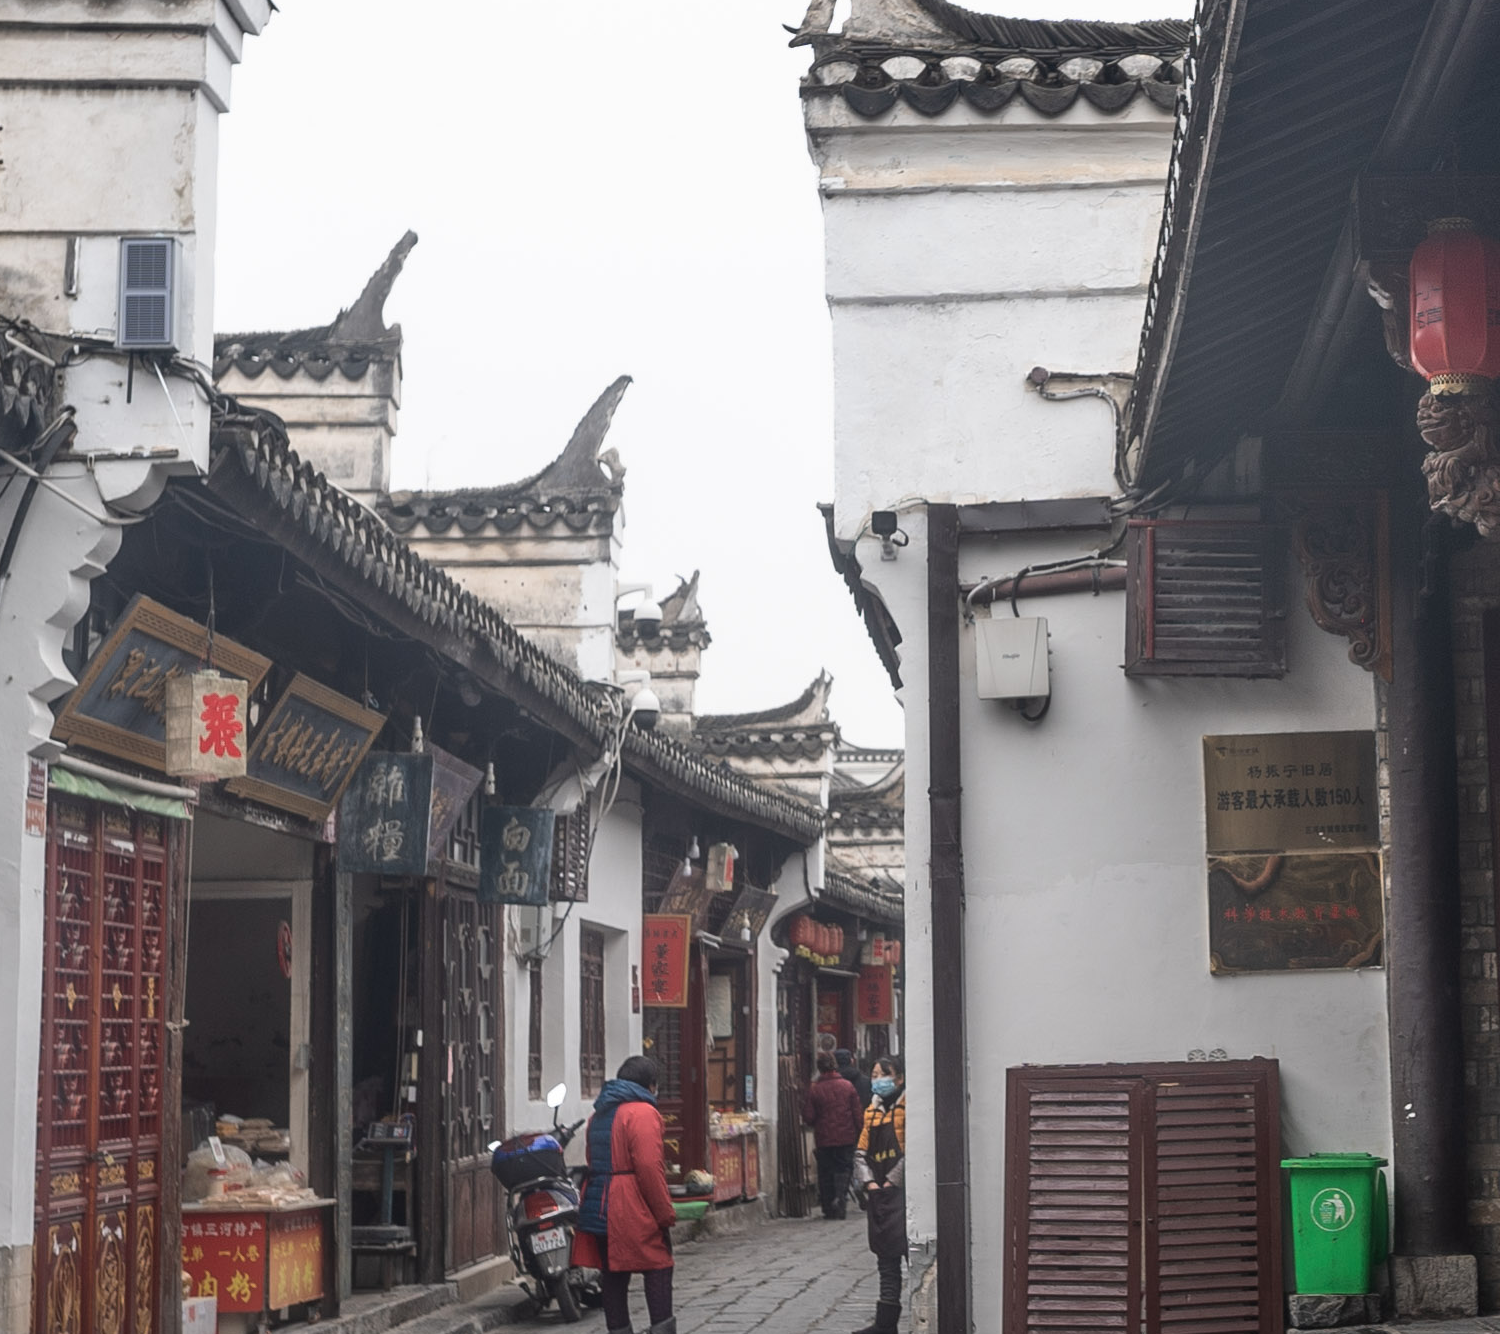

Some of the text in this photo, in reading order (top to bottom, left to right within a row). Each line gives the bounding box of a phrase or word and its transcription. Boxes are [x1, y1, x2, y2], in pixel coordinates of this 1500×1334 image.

[1247, 763, 1333, 779] 杨振宁旧居
[1217, 787, 1365, 811] 游客最大承载人数150人
